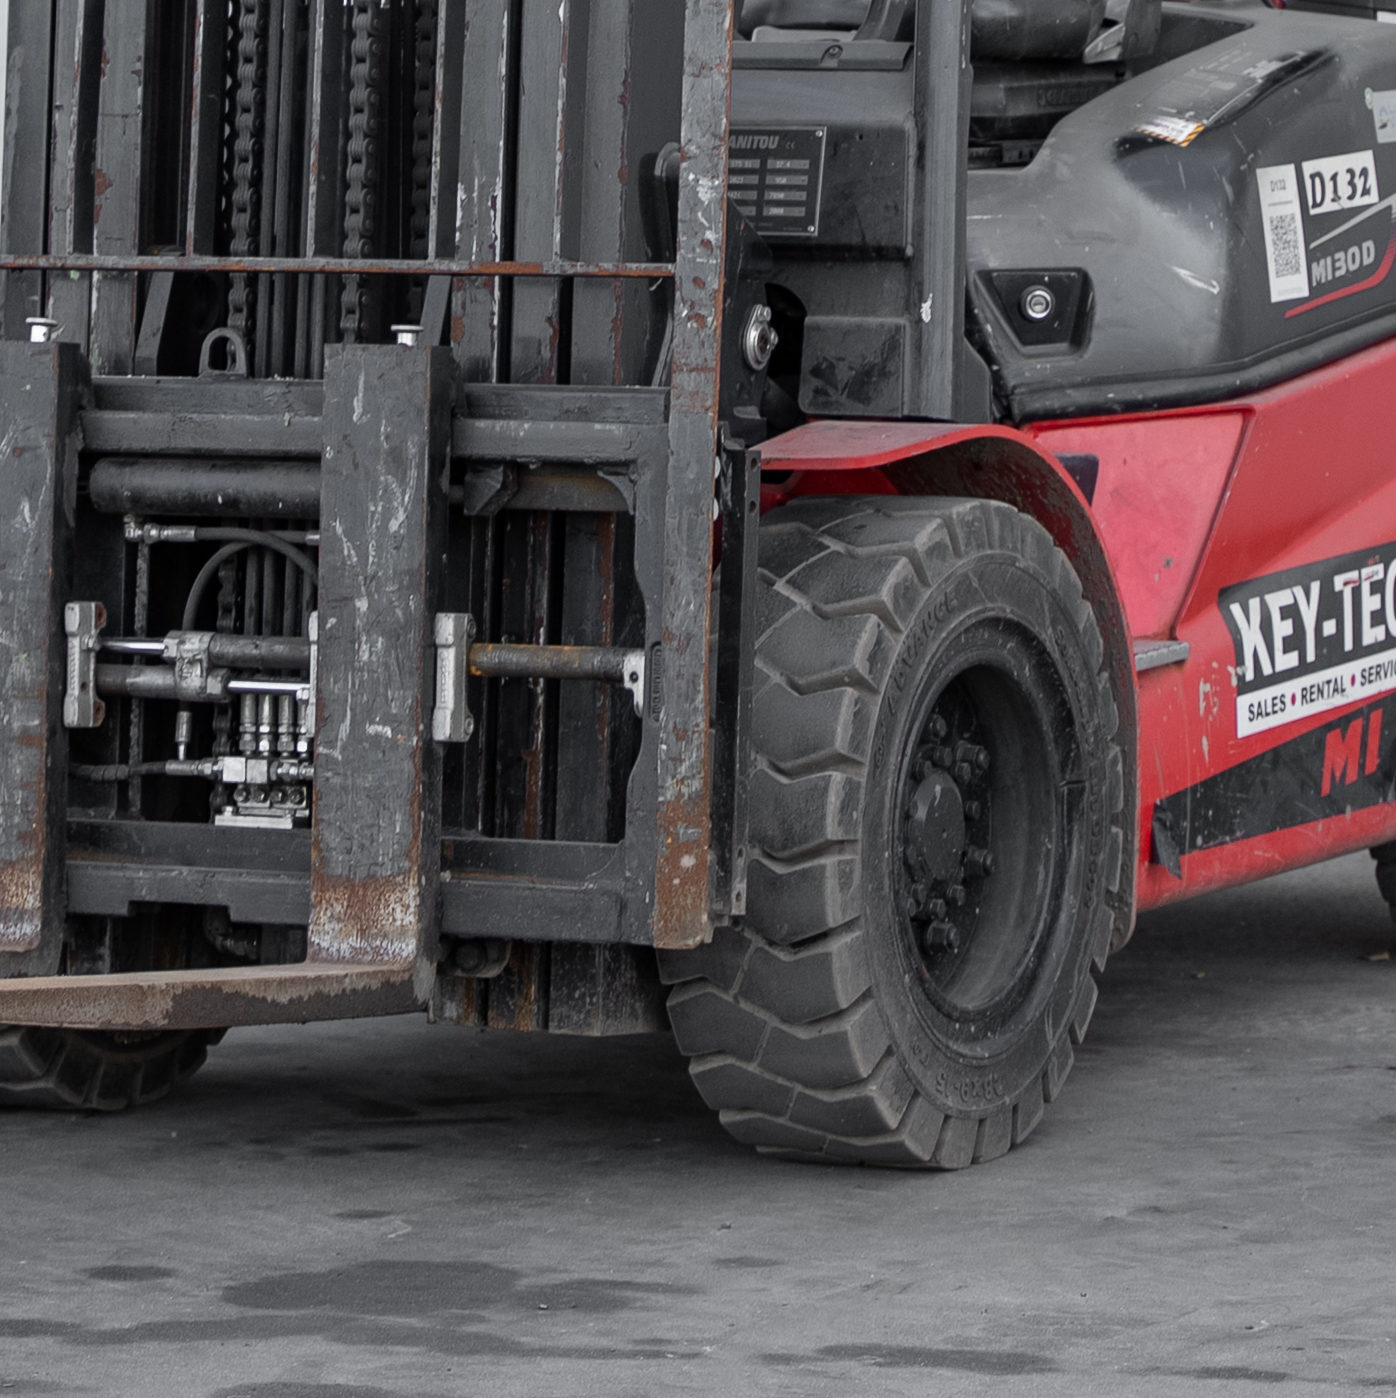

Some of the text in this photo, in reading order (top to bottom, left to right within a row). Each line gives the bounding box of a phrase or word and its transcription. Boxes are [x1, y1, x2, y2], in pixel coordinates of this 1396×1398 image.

[728, 135, 779, 149] ANITOU
[1270, 179, 1287, 192] D132
[1308, 166, 1372, 210] D132
[1311, 240, 1376, 287] MI30D
[1248, 692, 1286, 723] SALES
[1301, 678, 1347, 707] RENTAL
[1321, 708, 1383, 797] MI
